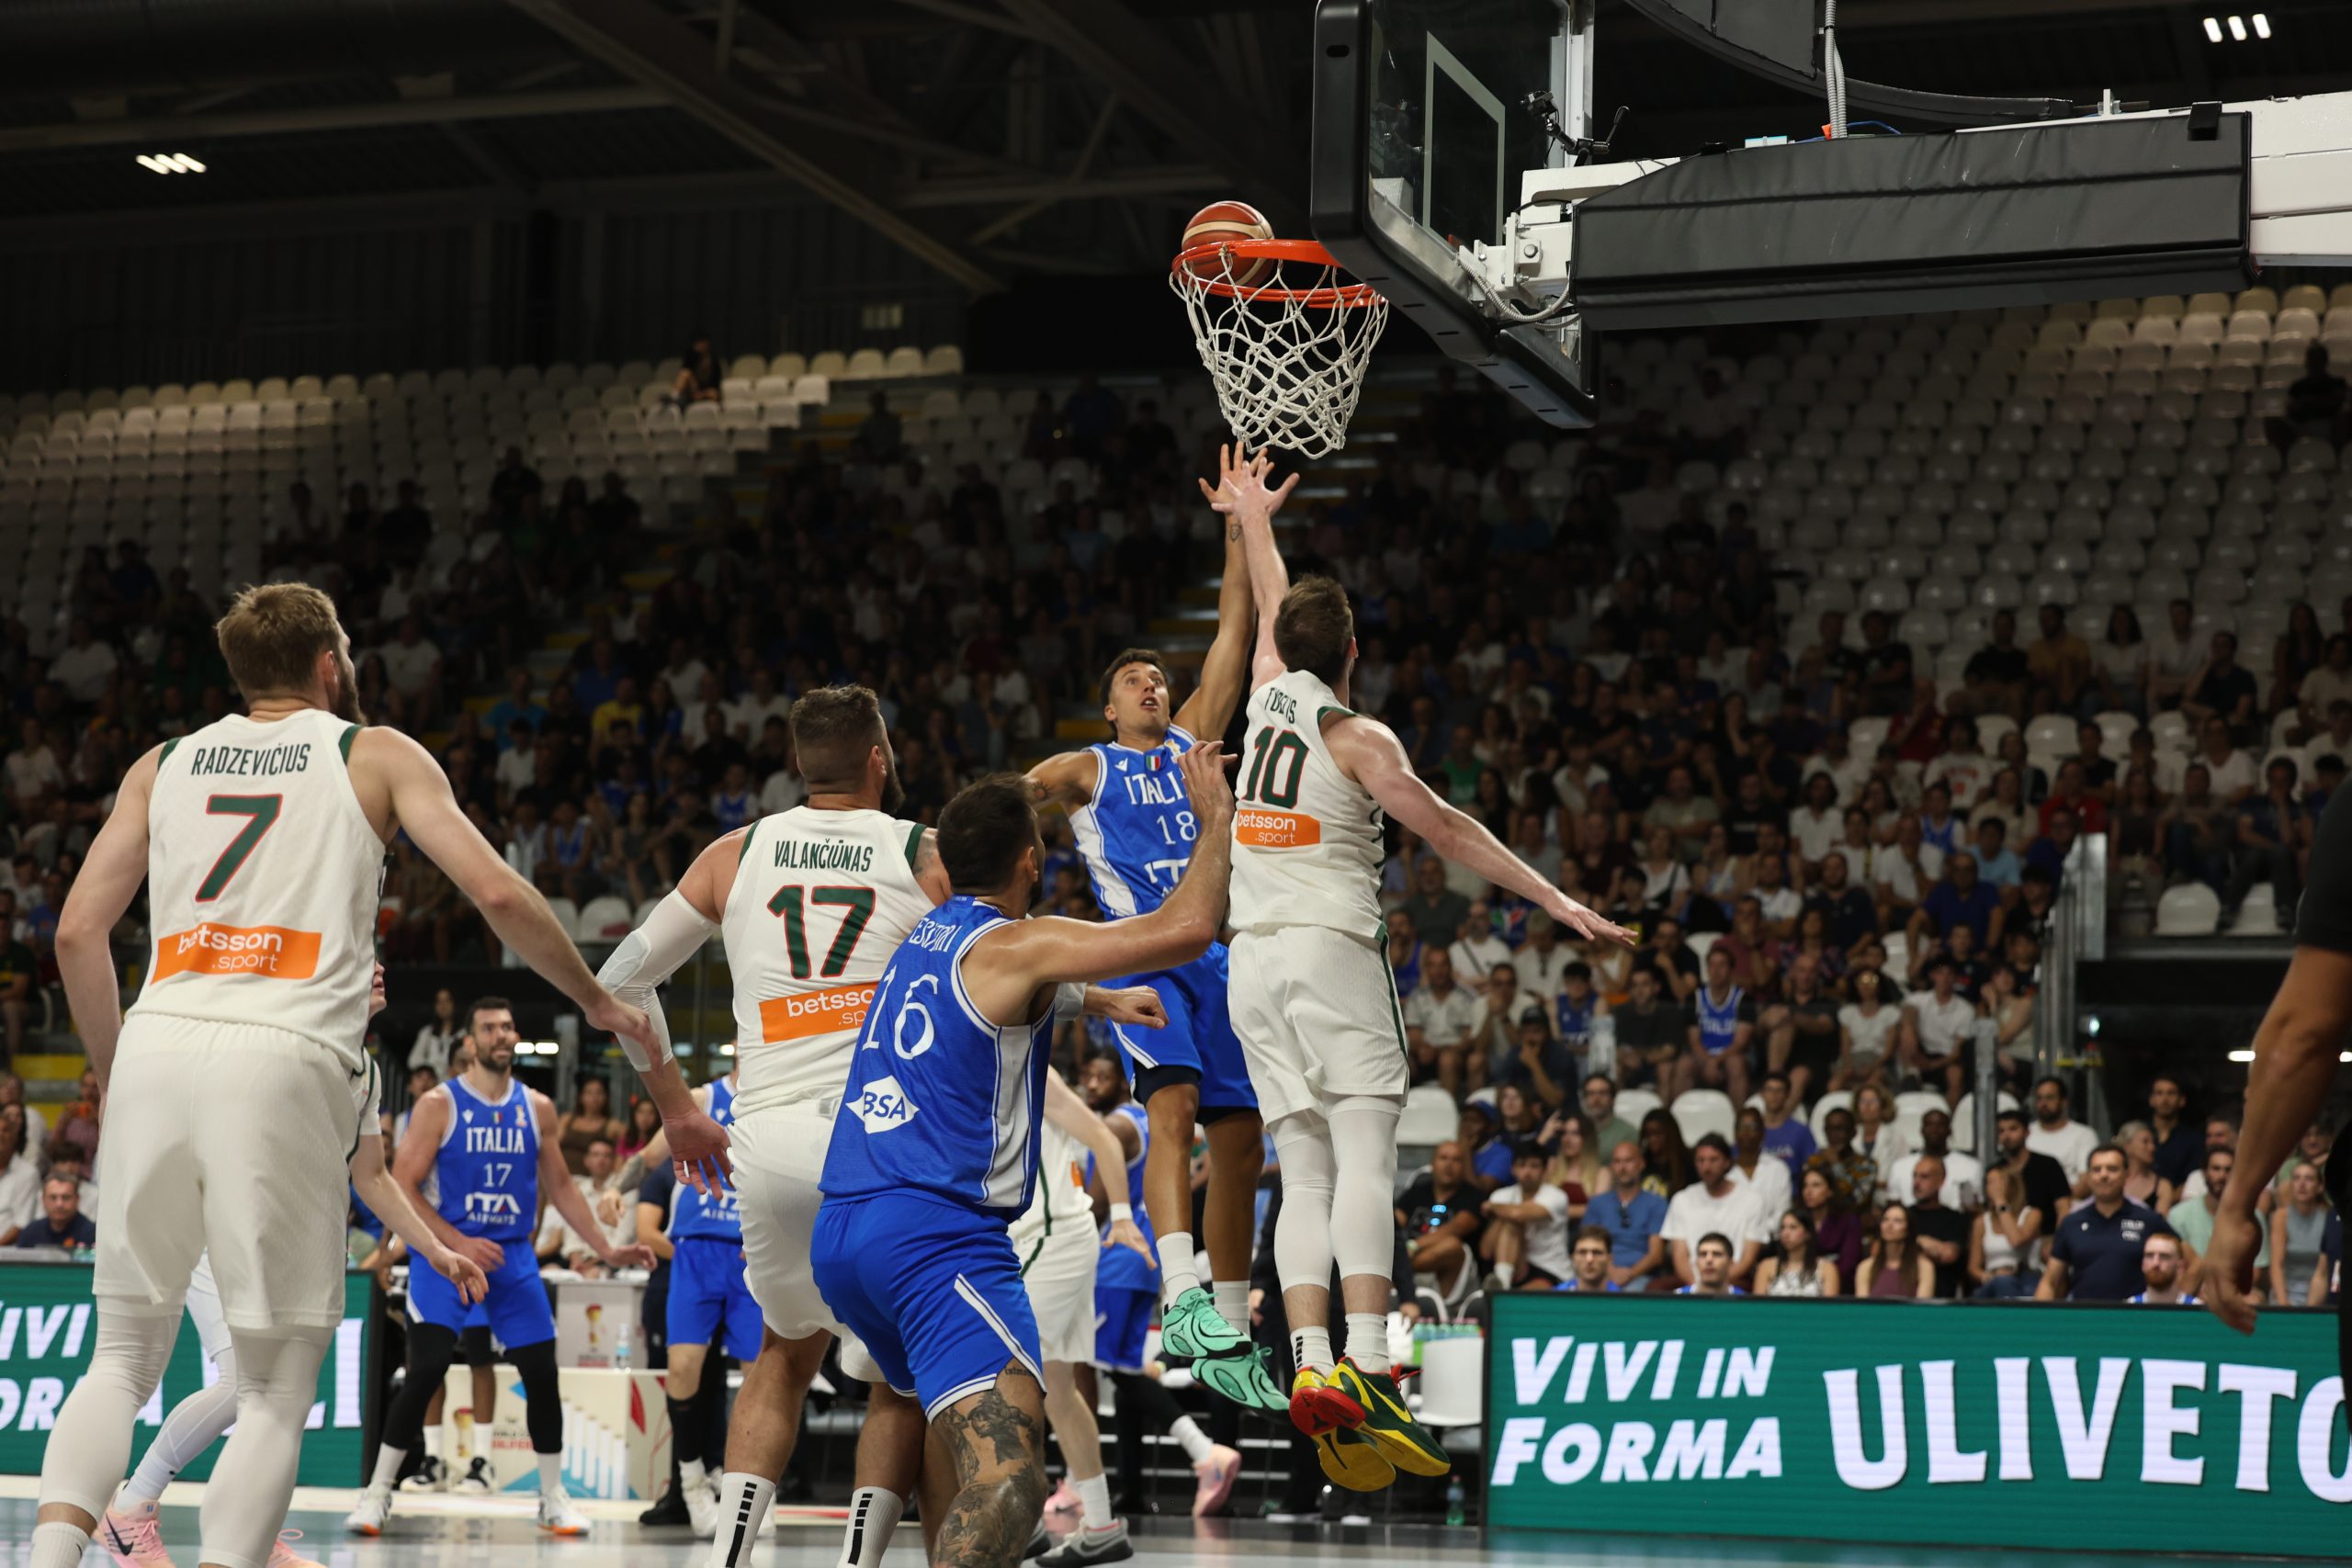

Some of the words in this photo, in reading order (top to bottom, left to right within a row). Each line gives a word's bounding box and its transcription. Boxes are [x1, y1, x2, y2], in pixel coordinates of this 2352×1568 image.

[191, 742, 311, 776] RADZEVIČIUS
[1240, 726, 1310, 810] 10
[1124, 769, 1189, 806] ITALI
[1157, 810, 1198, 845] 18
[1238, 811, 1296, 831] betsson
[195, 793, 283, 902] 7
[775, 838, 873, 872] VALANČIŪNAS
[1144, 857, 1191, 884] IT
[177, 924, 283, 955] betsson
[766, 885, 876, 979] 17
[786, 988, 875, 1018] betsso
[838, 1010, 867, 1026] .sp
[862, 964, 939, 1060] 16
[863, 1091, 907, 1120] BSA
[466, 1127, 526, 1154] ITALIA
[483, 1162, 513, 1188] 17
[465, 1191, 522, 1214] ITA
[701, 1207, 741, 1221] AIRW
[0, 1301, 91, 1360] IVI
[1511, 1336, 1685, 1405] VIVI
[1696, 1346, 1776, 1398] IN
[1823, 1356, 2352, 1503] ULIVETO
[1490, 1416, 1782, 1486] FORMA
